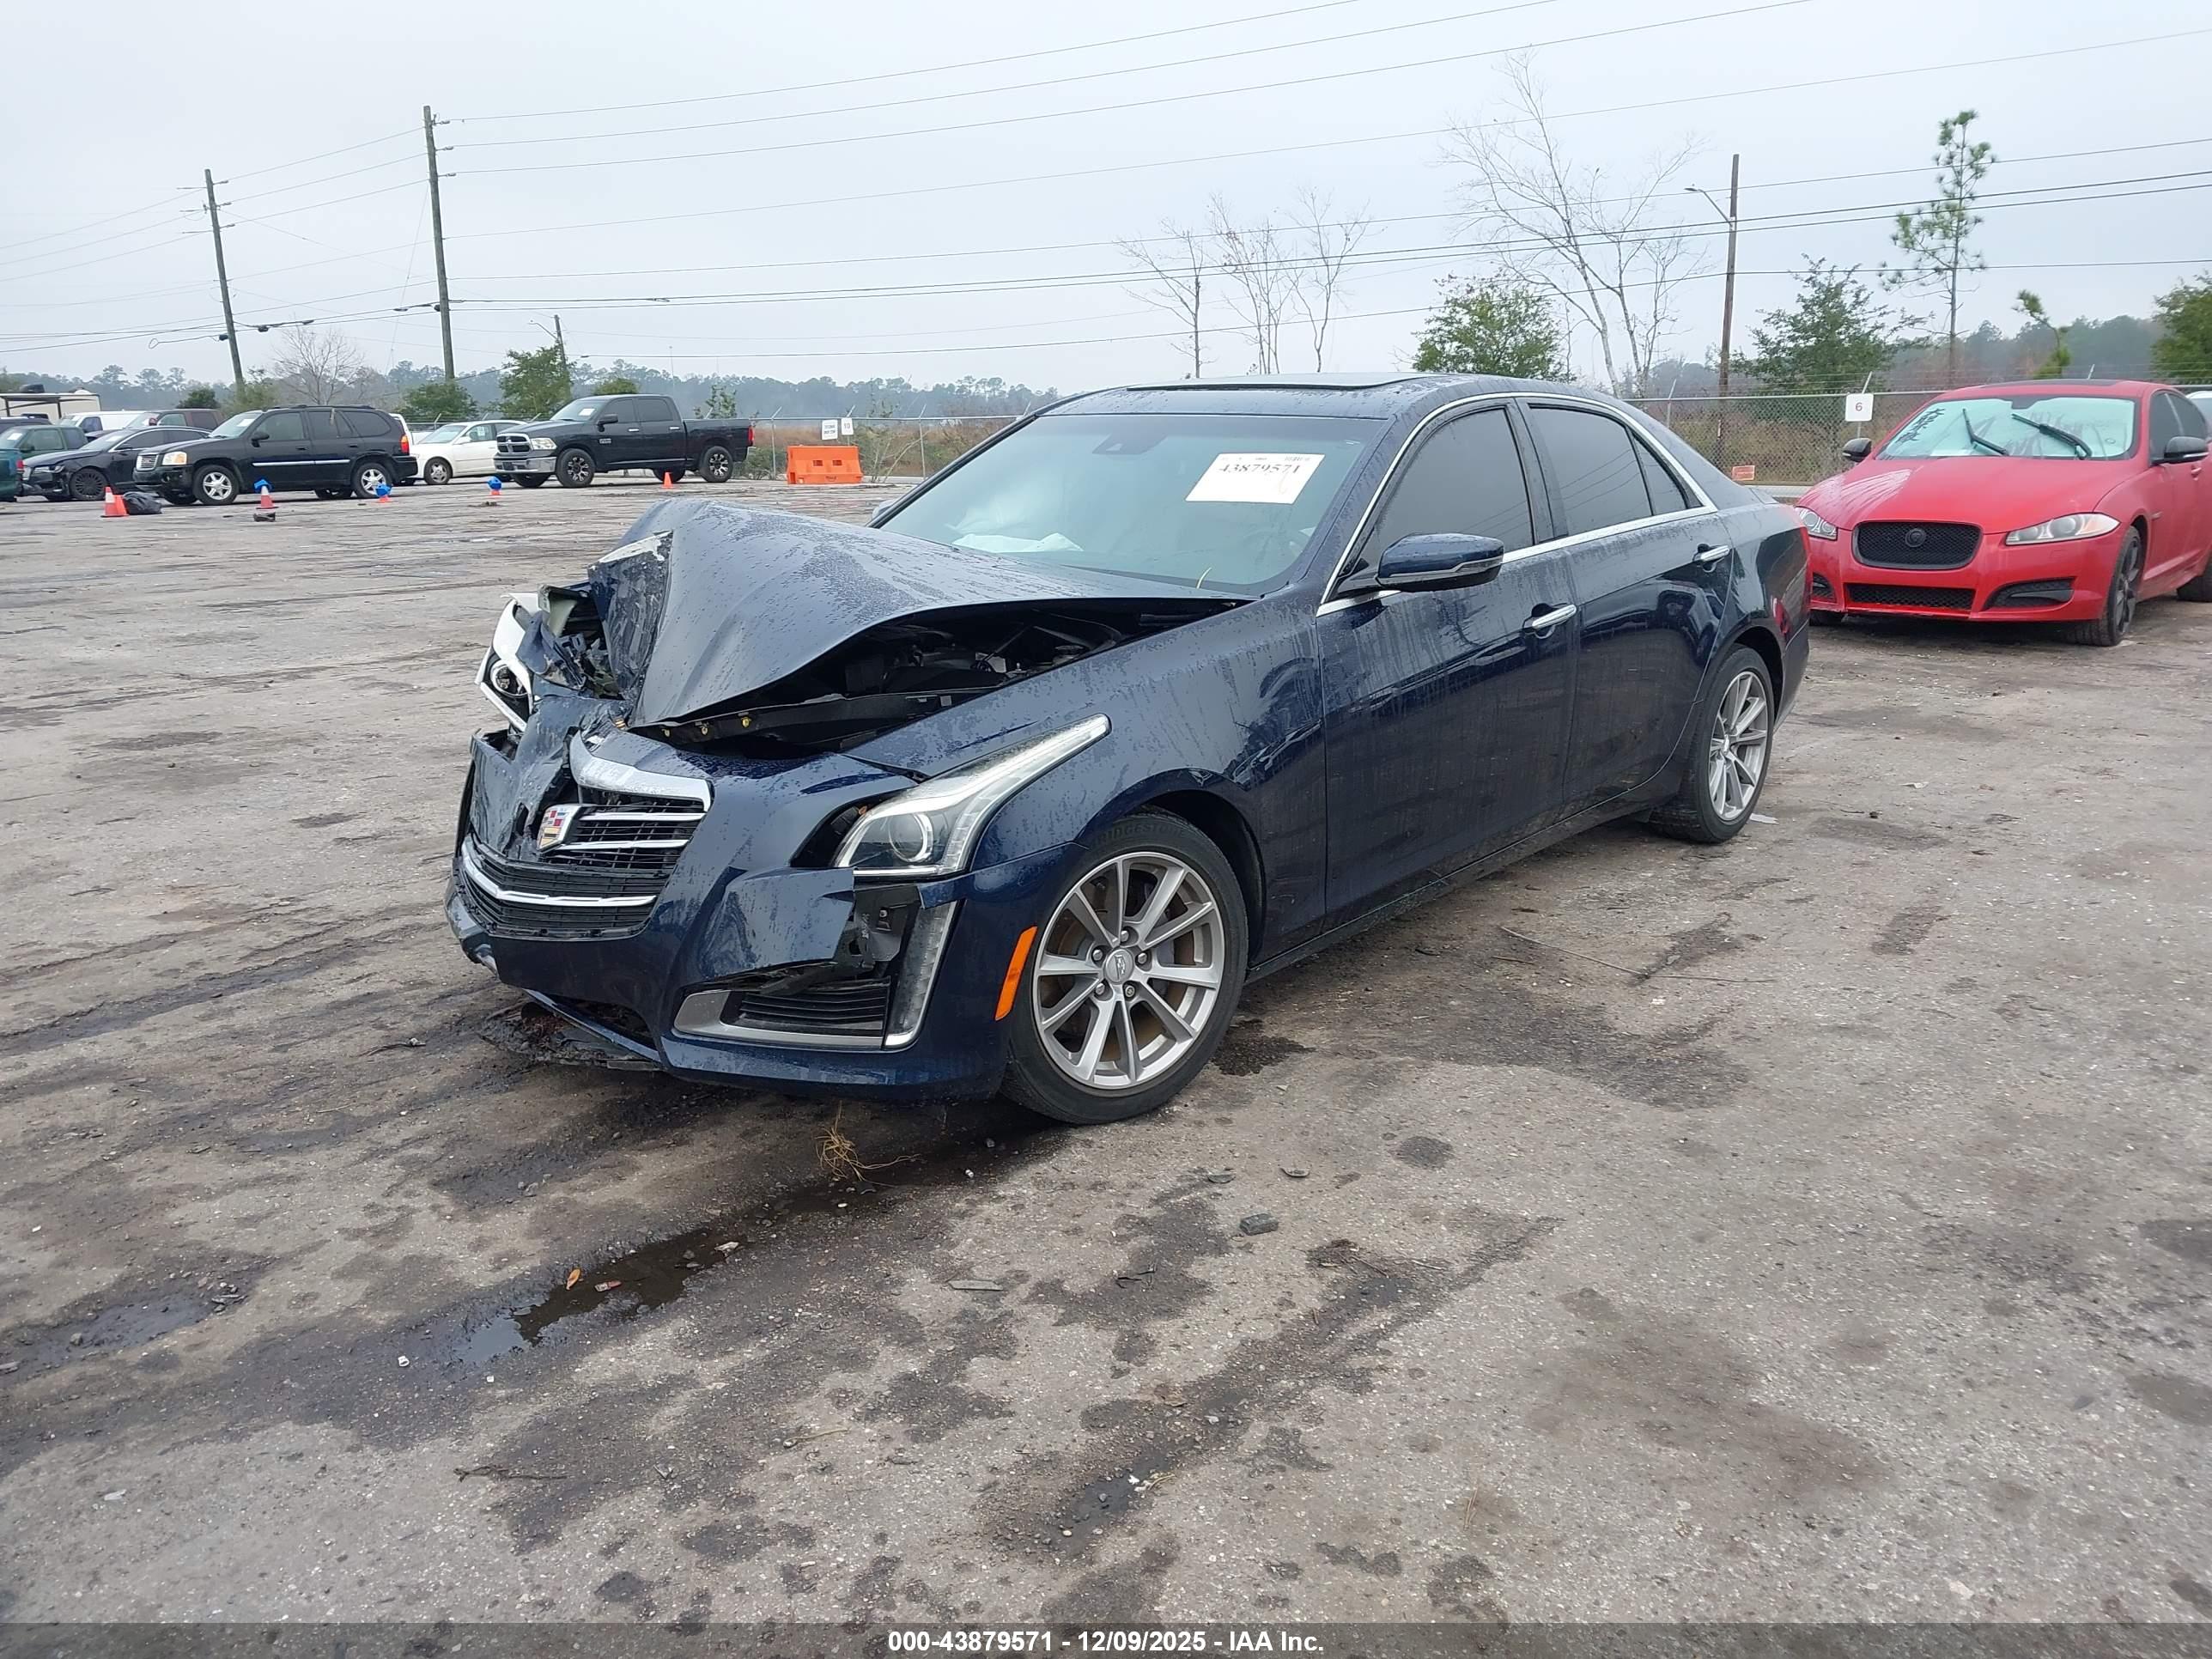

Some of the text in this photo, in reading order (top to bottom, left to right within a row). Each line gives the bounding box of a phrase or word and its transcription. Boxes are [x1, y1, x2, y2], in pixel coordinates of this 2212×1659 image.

[1855, 402, 1863, 412] 6
[1218, 464, 1300, 473] 43879571
[1097, 823, 1187, 844] RIDGESTONE
